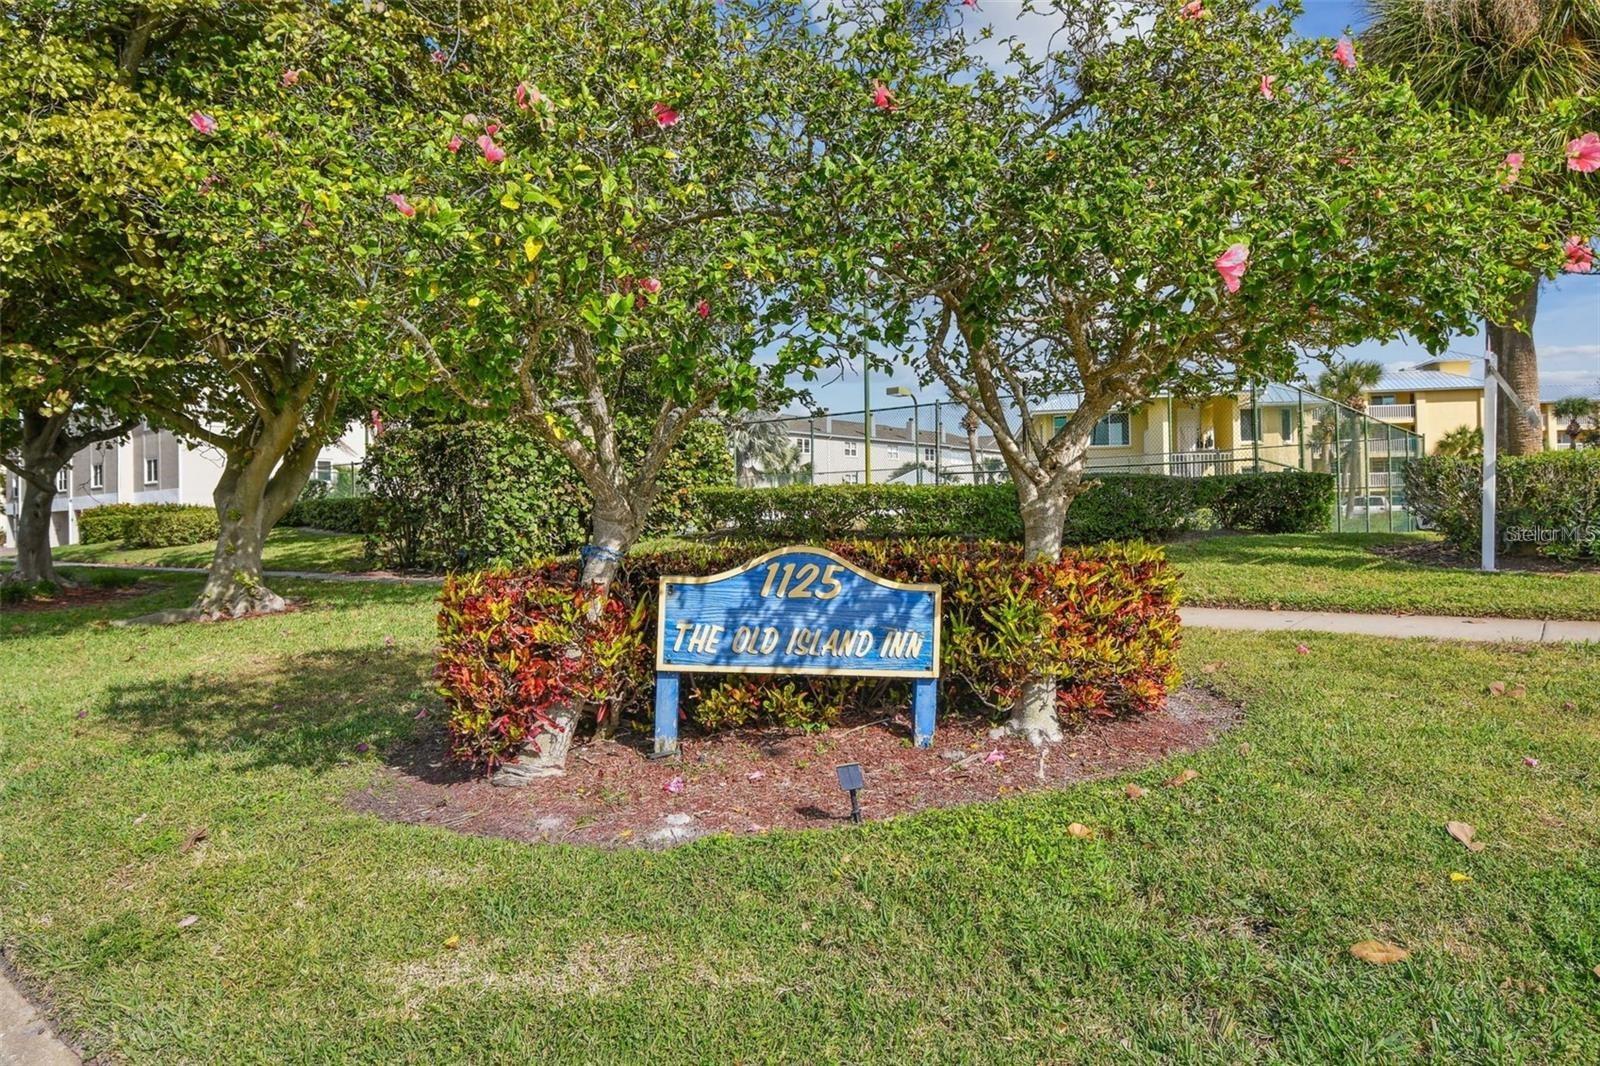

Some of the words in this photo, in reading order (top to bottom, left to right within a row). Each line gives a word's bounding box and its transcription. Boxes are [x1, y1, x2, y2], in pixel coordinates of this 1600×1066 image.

[760, 562, 844, 600] 1125
[673, 623, 724, 654] THE
[731, 626, 779, 655] OLD
[785, 628, 874, 658] ISLAND
[880, 631, 924, 659] INN
